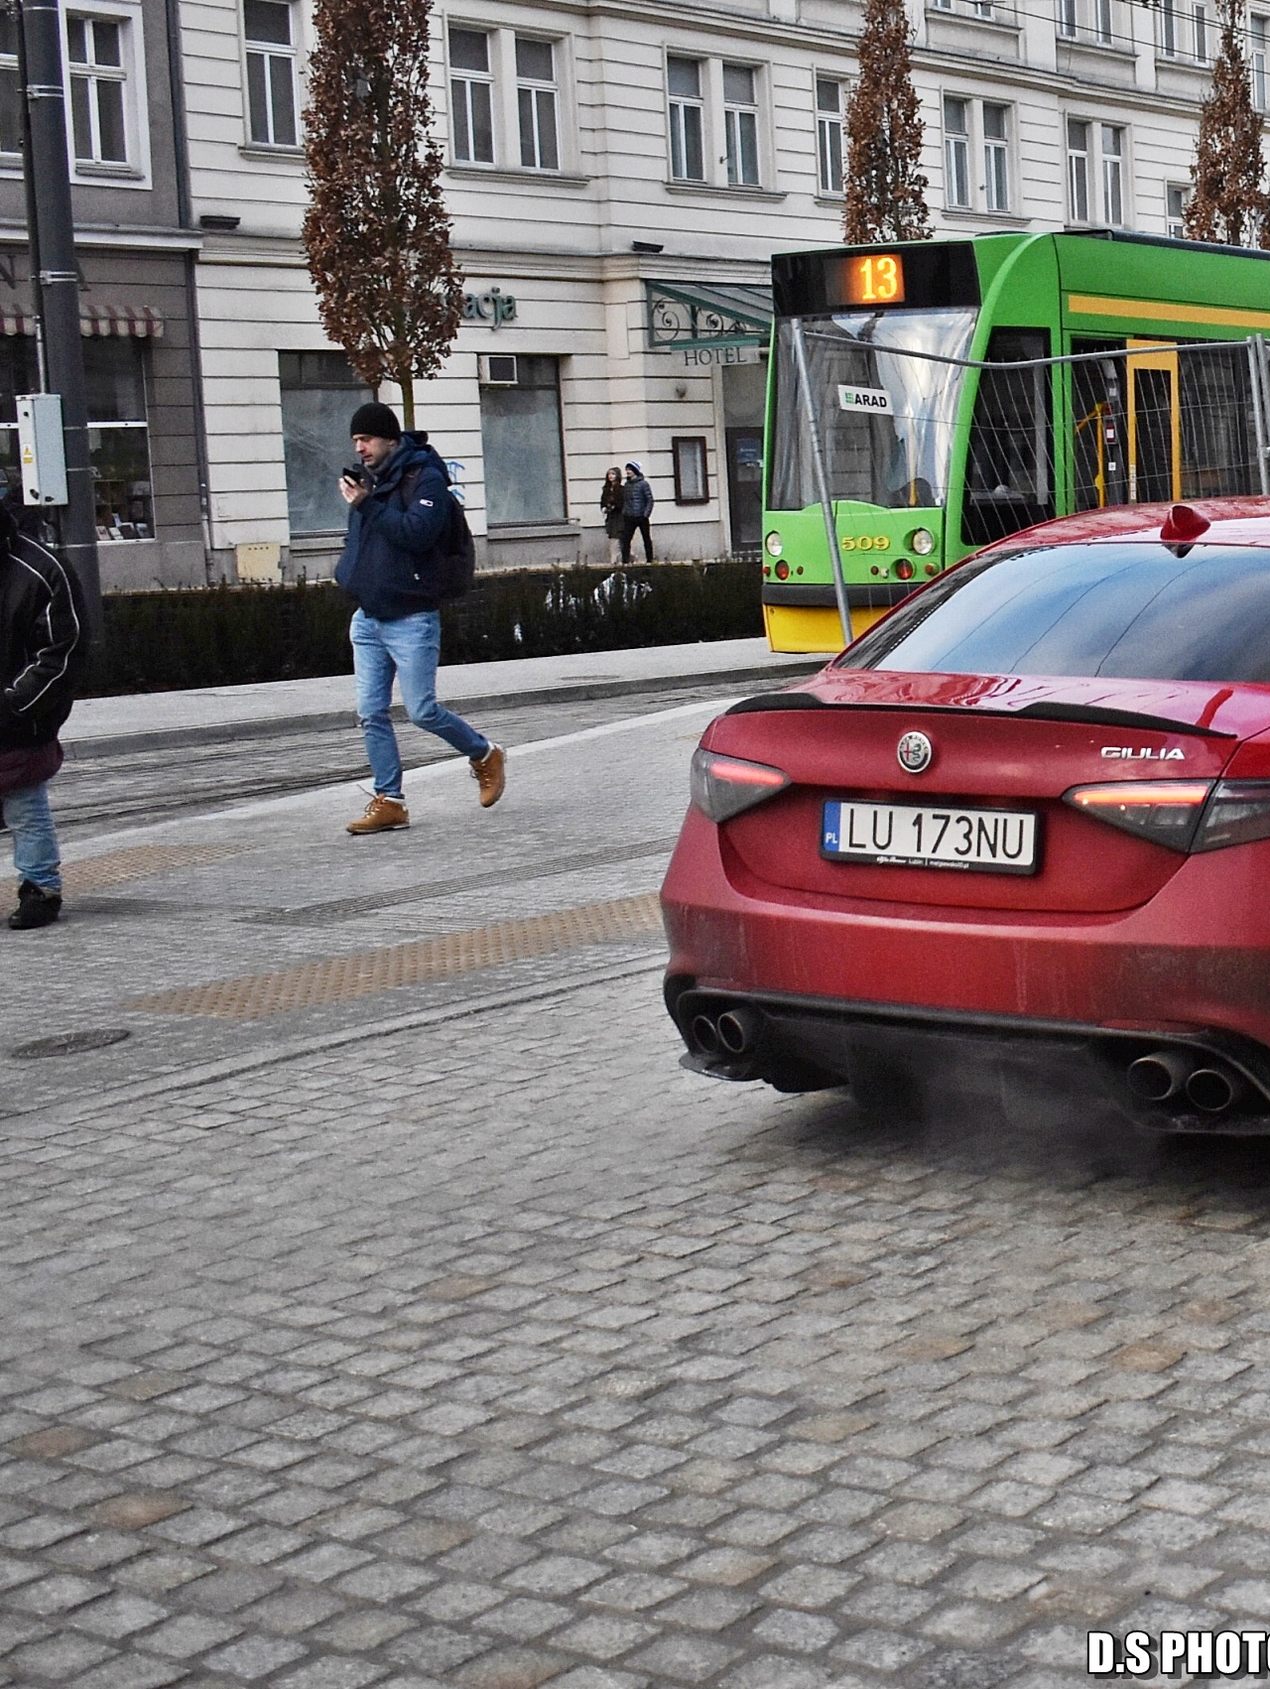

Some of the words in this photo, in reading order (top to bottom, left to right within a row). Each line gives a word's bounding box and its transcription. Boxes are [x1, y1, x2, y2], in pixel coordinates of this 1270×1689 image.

[861, 257, 898, 300] 13
[684, 347, 746, 366] HOTEL
[854, 393, 888, 408] ARAD
[841, 535, 890, 551] 509
[1101, 746, 1186, 761] GIULIA
[825, 832, 838, 844] PL
[848, 807, 894, 851] LU
[911, 812, 1025, 860] 173NU
